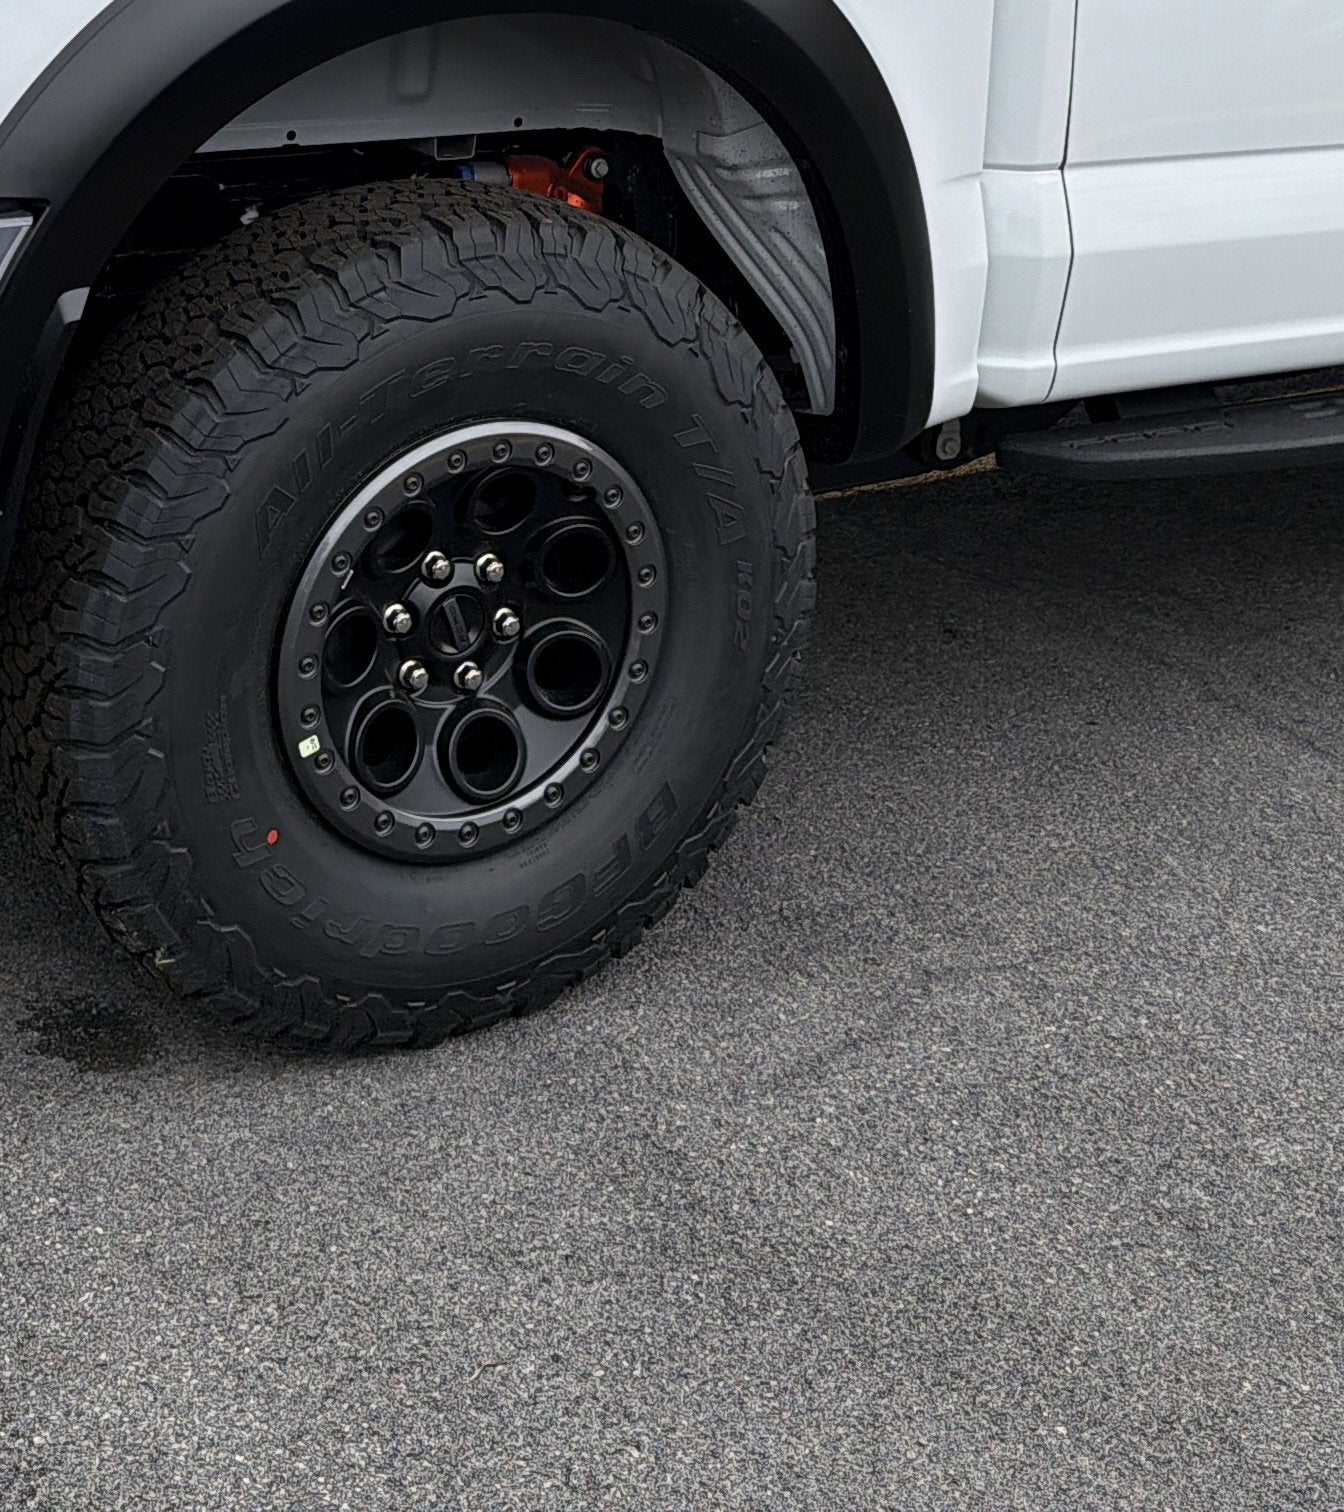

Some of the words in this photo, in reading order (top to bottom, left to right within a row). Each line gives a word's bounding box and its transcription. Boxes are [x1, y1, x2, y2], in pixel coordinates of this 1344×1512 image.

[255, 340, 669, 550] All-Terrain
[674, 413, 748, 546] T/A
[230, 778, 678, 958] BFGoodrich
